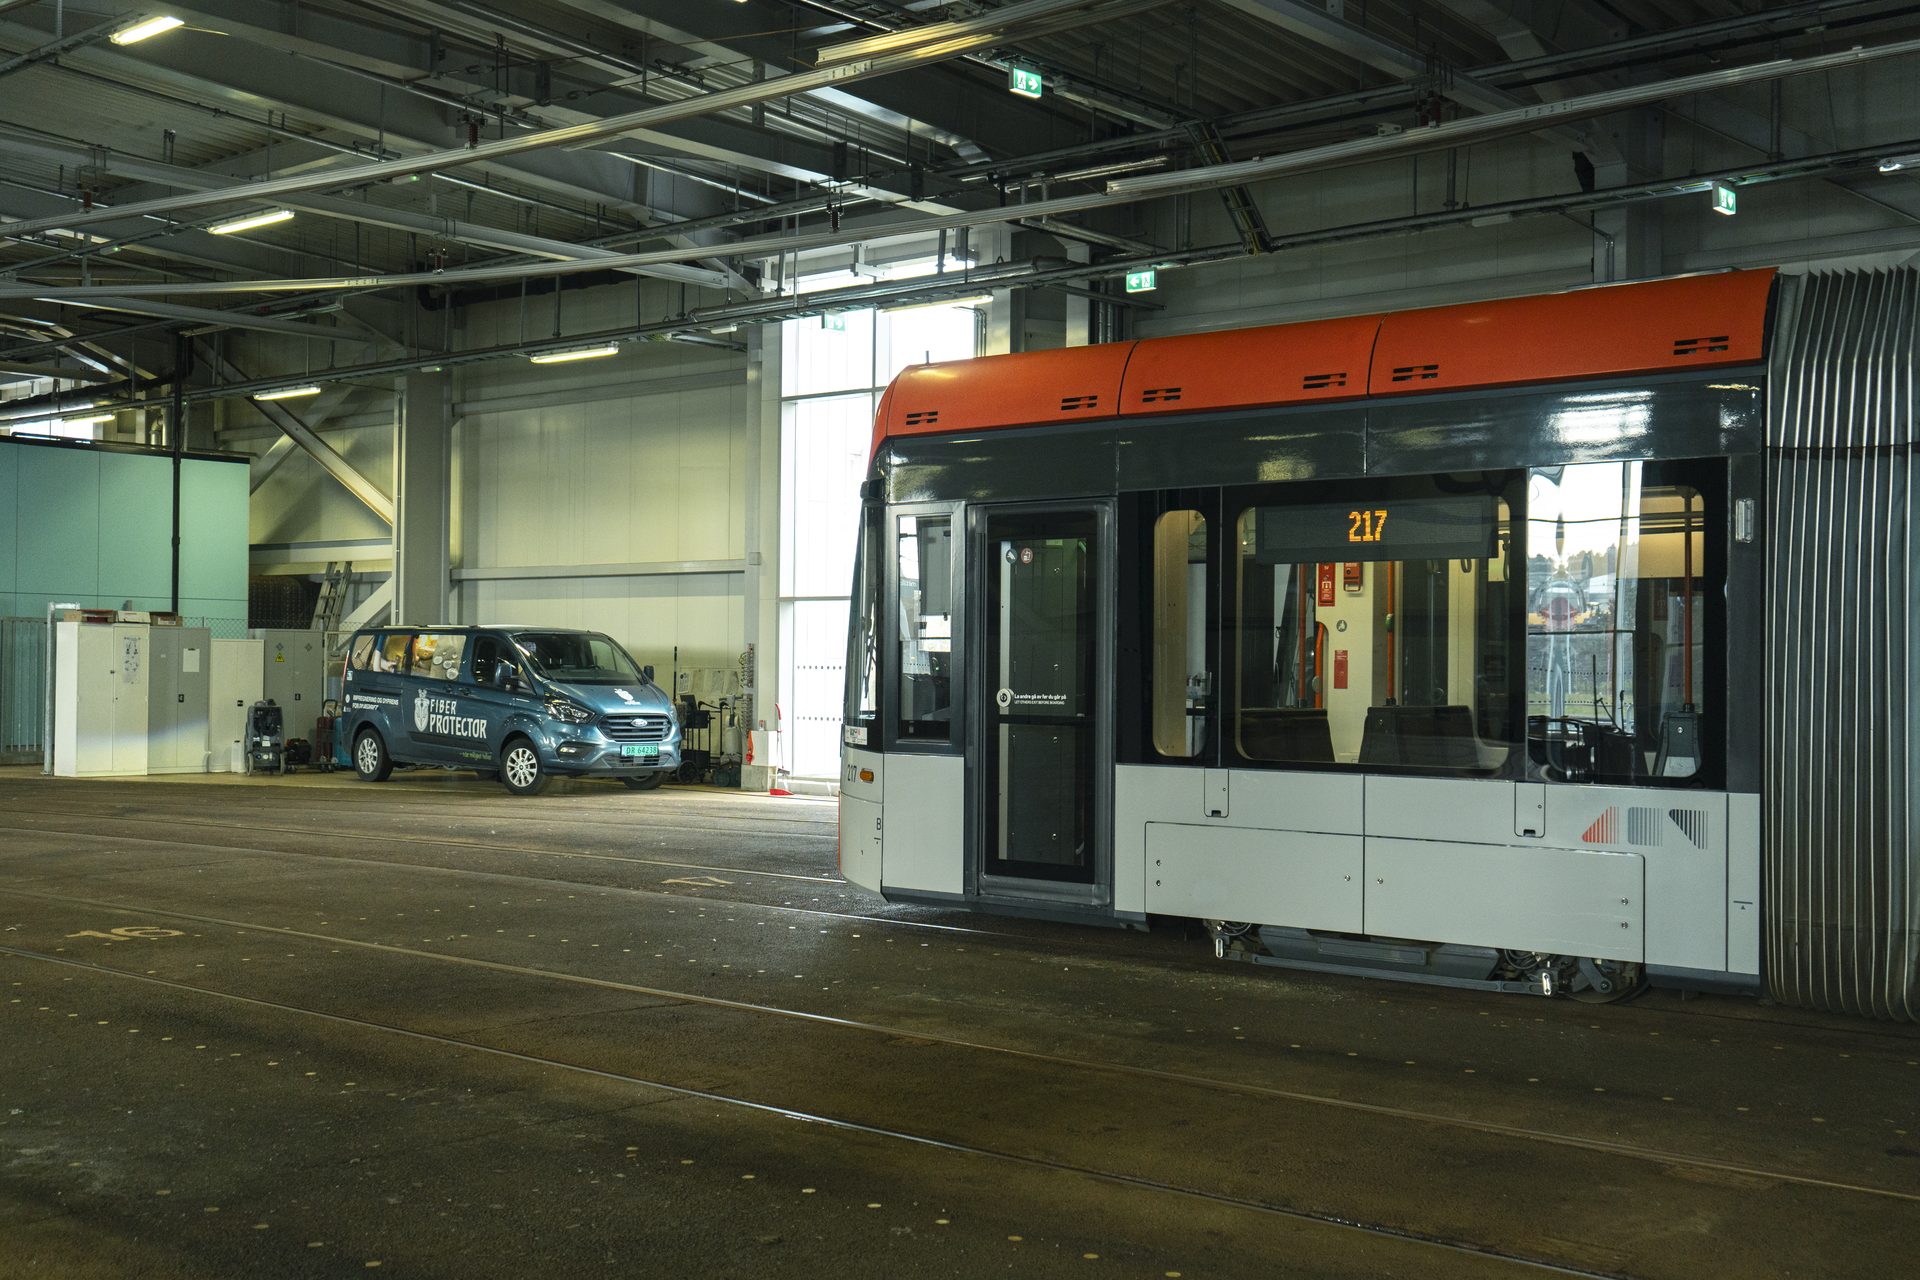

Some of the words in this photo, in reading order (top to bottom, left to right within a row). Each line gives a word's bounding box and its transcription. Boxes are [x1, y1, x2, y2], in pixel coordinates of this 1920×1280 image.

[1349, 510, 1388, 542] 217
[430, 699, 457, 715] FIBER
[429, 713, 488, 739] PROTECTOR
[626, 746, 636, 754] DR
[637, 746, 657, 754] 64238
[847, 764, 858, 783] 217
[876, 817, 882, 831] B
[65, 926, 185, 941] 16
